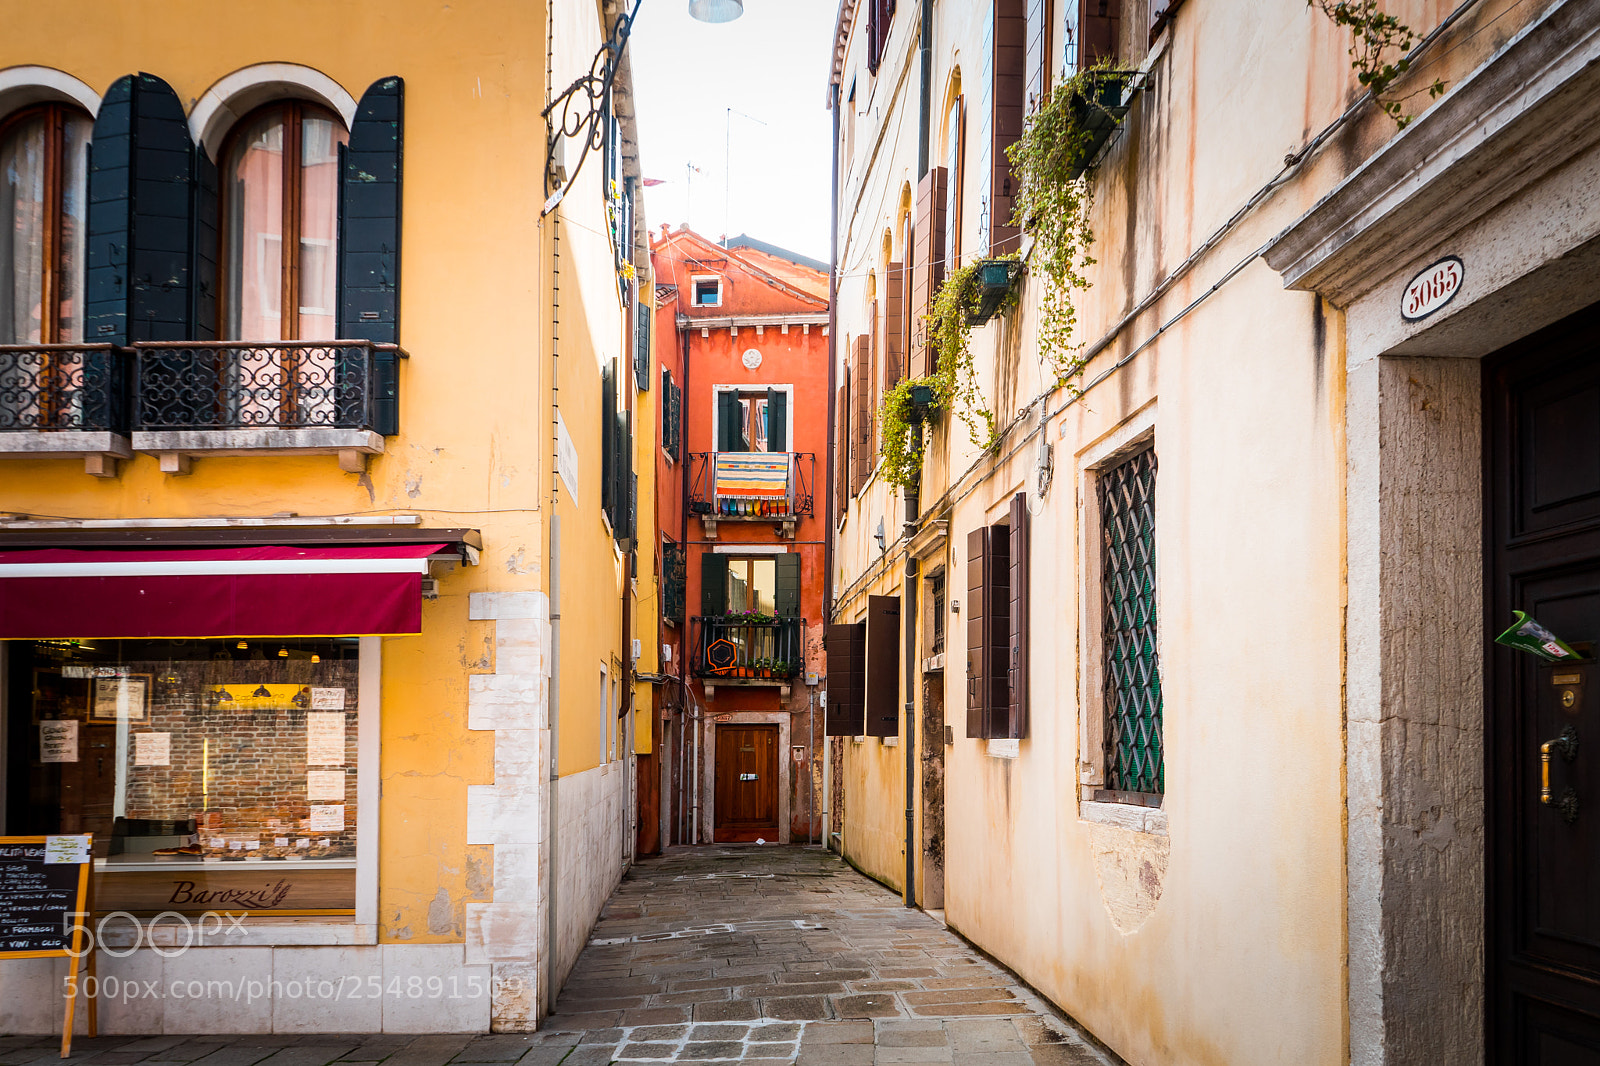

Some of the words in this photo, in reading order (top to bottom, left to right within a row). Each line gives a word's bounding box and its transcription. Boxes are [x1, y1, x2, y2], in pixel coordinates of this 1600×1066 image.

[1409, 262, 1458, 314] 3085
[168, 880, 270, 909] Barozzi
[9, 940, 30, 948] VINI
